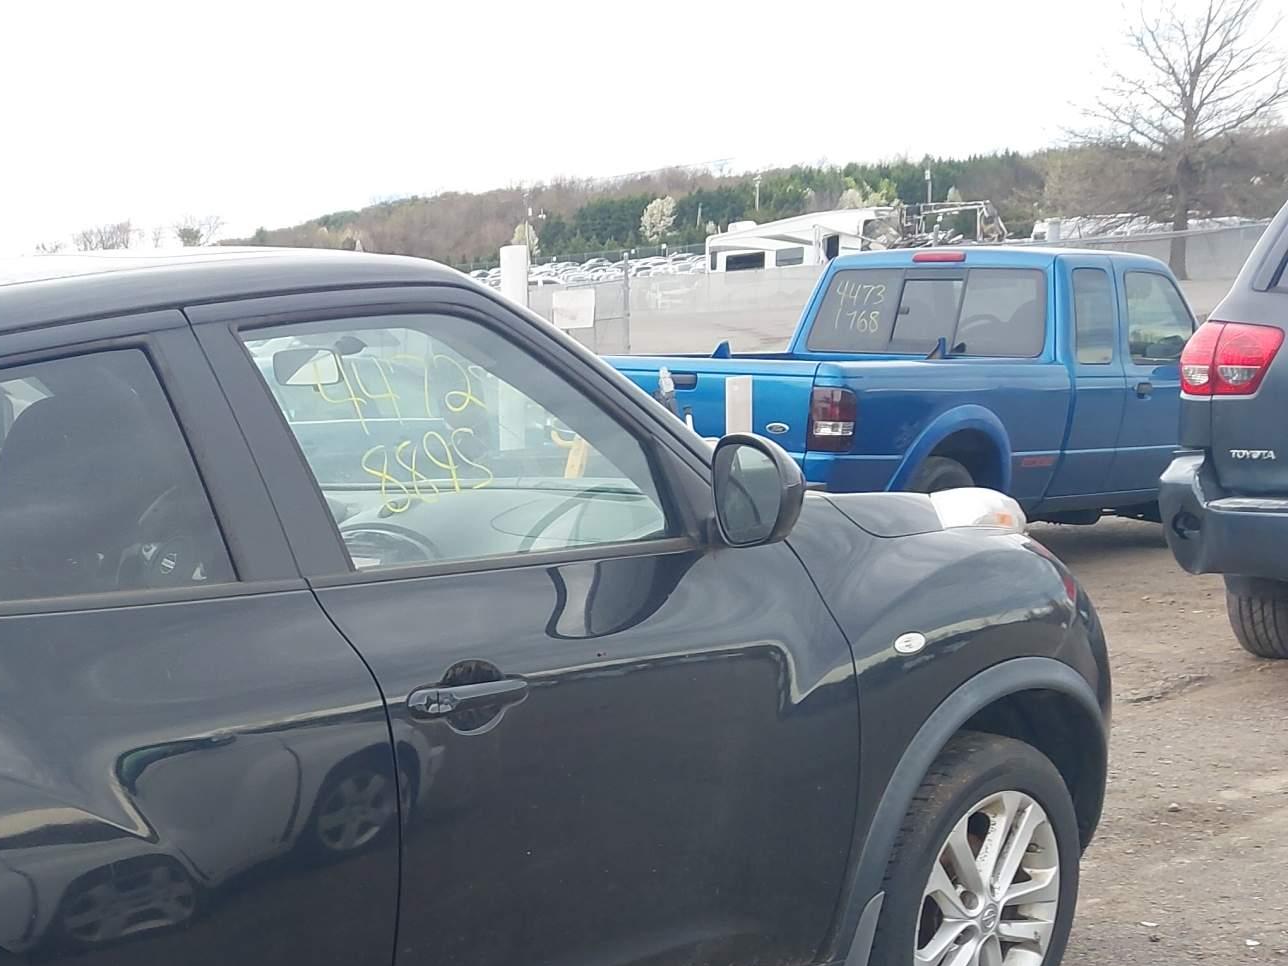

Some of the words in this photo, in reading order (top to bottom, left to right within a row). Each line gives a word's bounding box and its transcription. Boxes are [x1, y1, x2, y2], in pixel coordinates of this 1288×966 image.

[836, 279, 886, 305] 4473
[834, 307, 880, 333] 1768
[312, 353, 488, 435] 4472
[1229, 449, 1276, 460] TOYOTA
[361, 427, 493, 513] 8895
